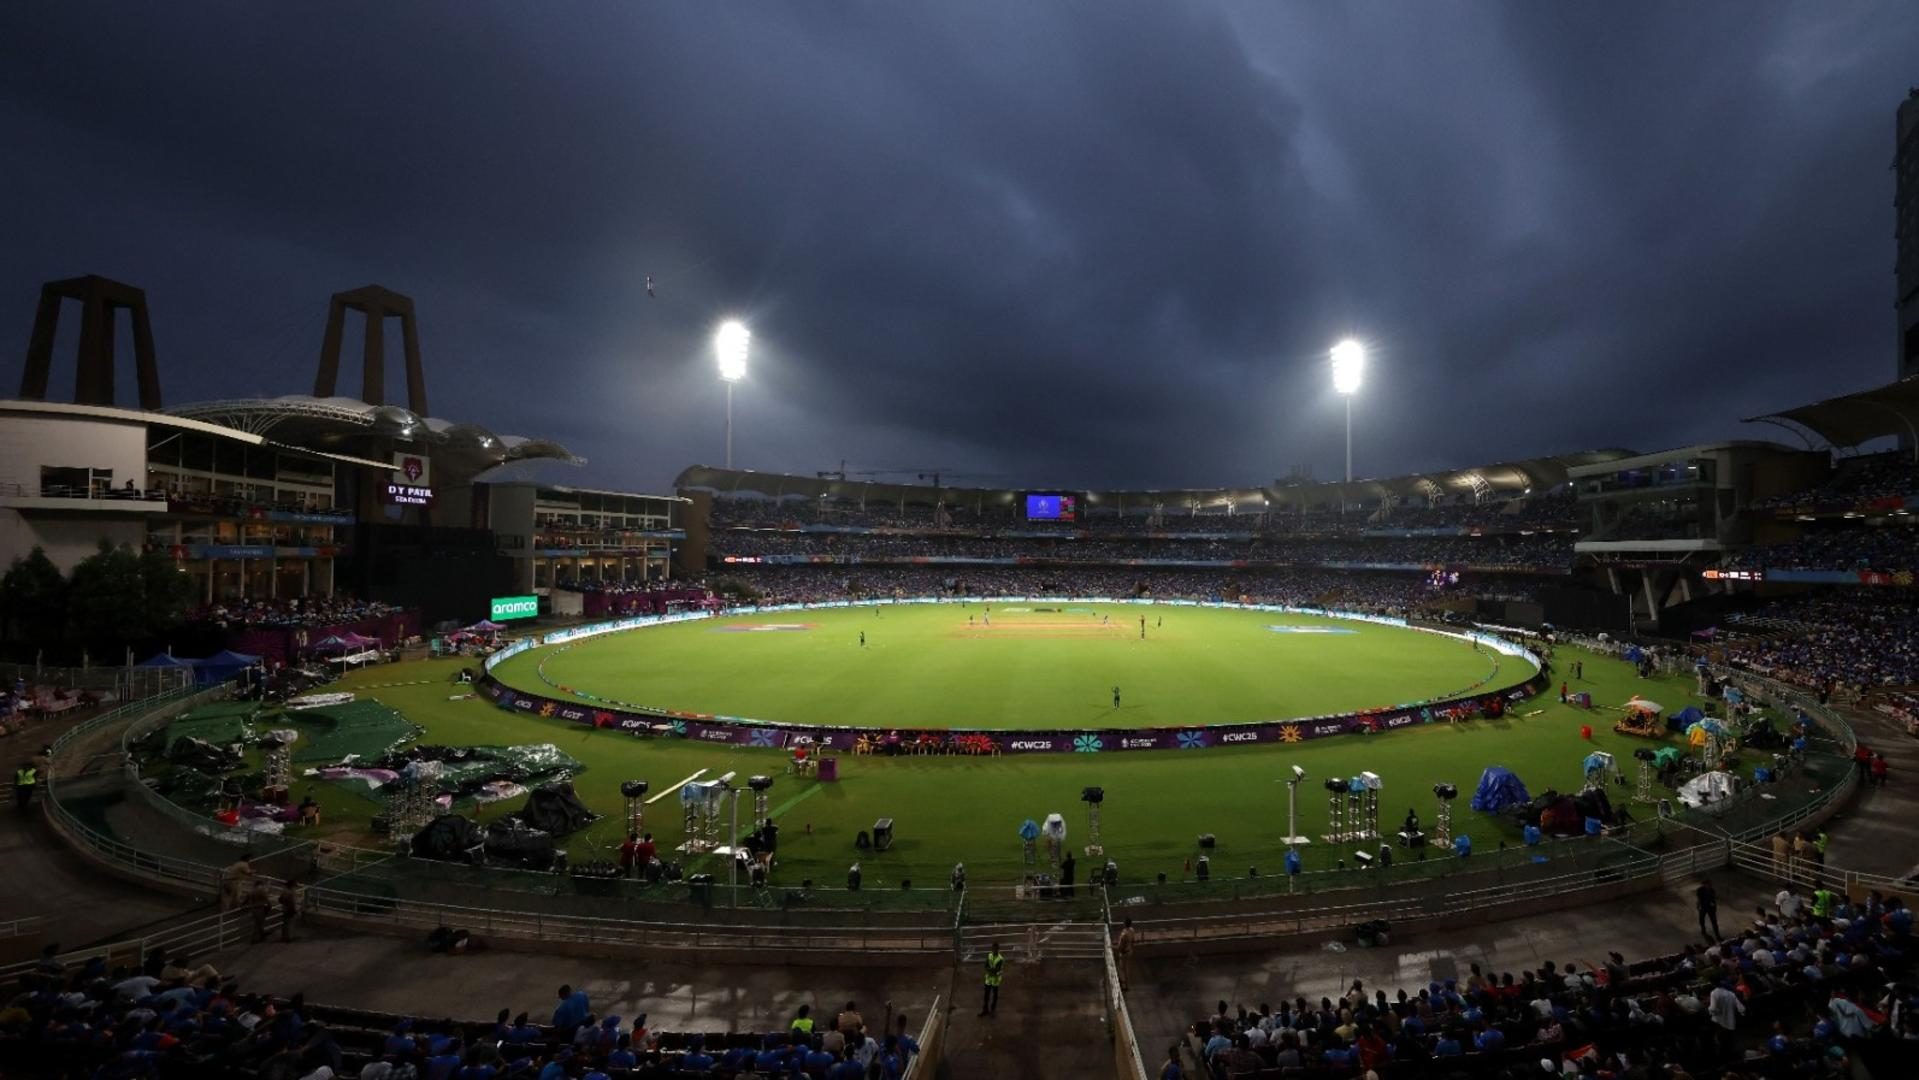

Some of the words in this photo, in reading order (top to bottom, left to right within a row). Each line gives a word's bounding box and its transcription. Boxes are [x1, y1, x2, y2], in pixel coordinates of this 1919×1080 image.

[388, 485, 397, 494] D
[398, 486, 405, 495] Y
[407, 487, 433, 498] PATIL
[493, 601, 537, 614] aramco
[1222, 732, 1258, 743] #CWC25
[1011, 740, 1052, 750] #CWC25
